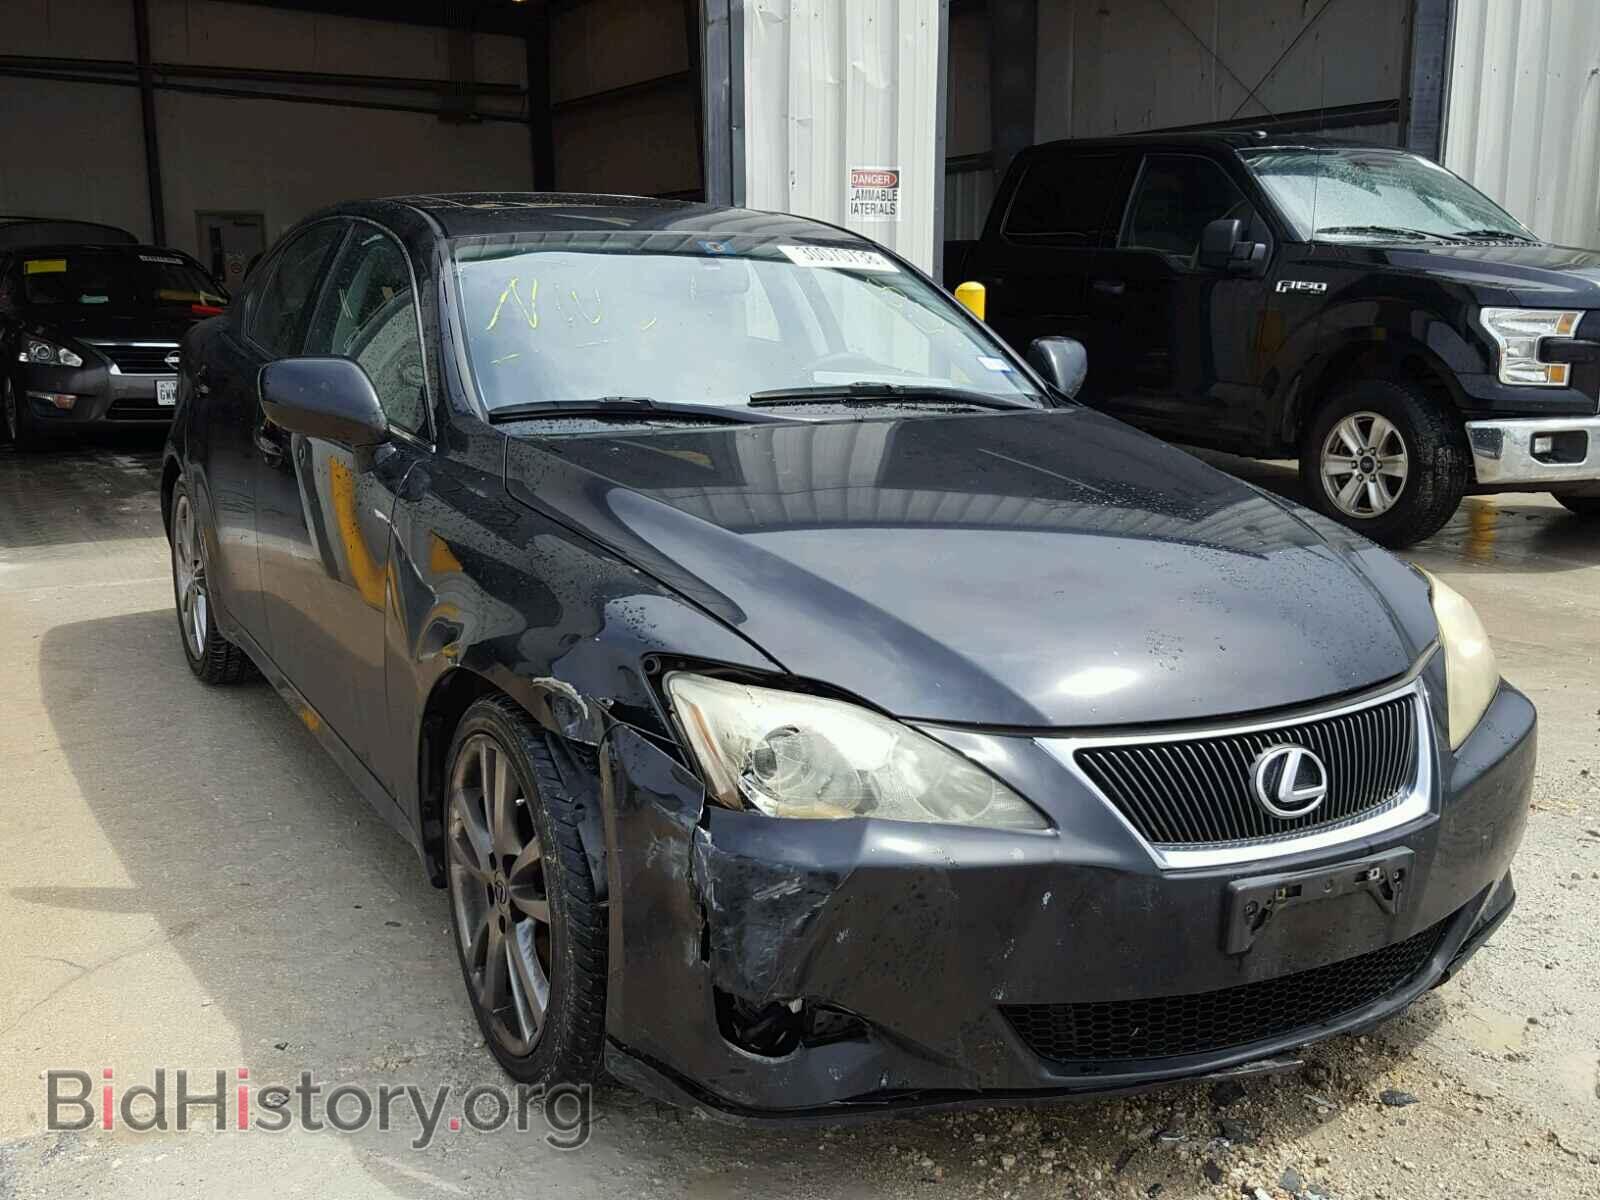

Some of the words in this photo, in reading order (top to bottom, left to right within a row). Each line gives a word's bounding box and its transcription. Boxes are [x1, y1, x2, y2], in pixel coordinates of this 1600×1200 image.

[852, 174, 890, 185] DANGER
[851, 189, 898, 201] AMMABLE
[850, 203, 896, 215] ATERIALS
